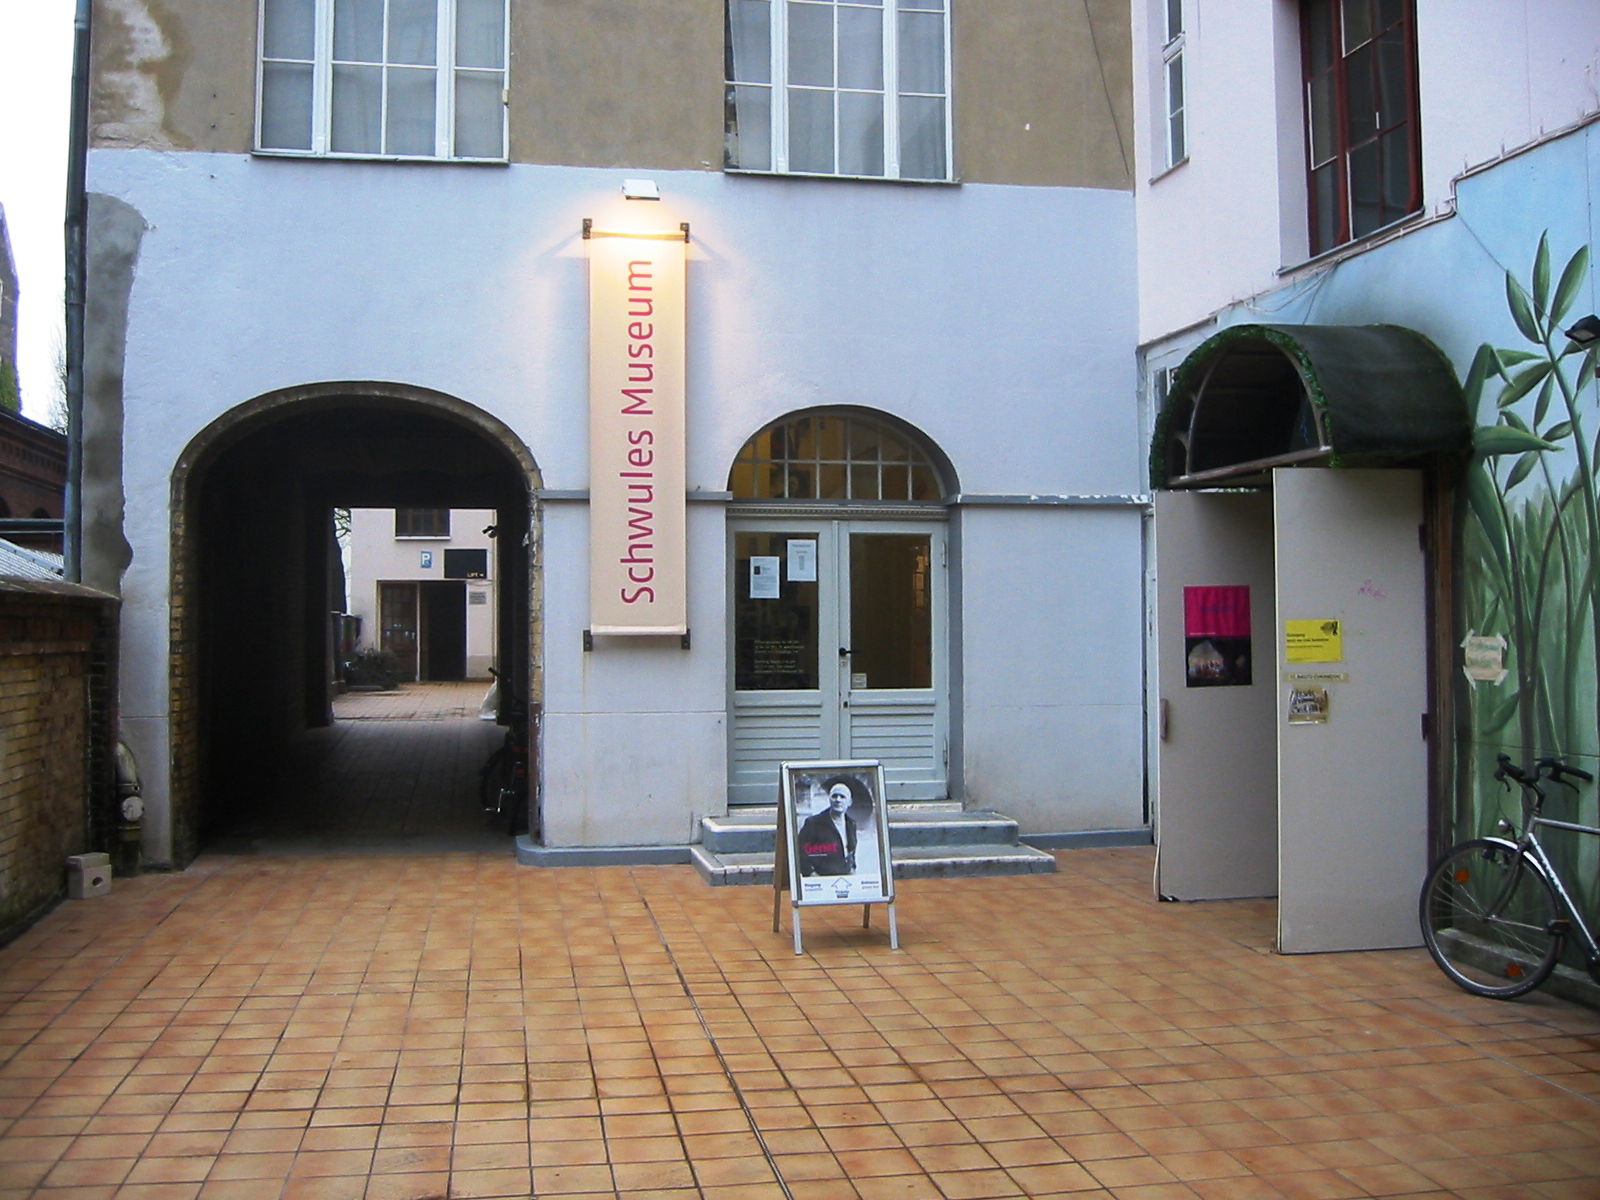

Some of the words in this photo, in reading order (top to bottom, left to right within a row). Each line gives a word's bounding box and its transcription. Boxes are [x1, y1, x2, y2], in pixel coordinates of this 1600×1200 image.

[620, 260, 656, 415] Museum
[422, 553, 430, 565] P
[619, 429, 656, 605] Schwules
